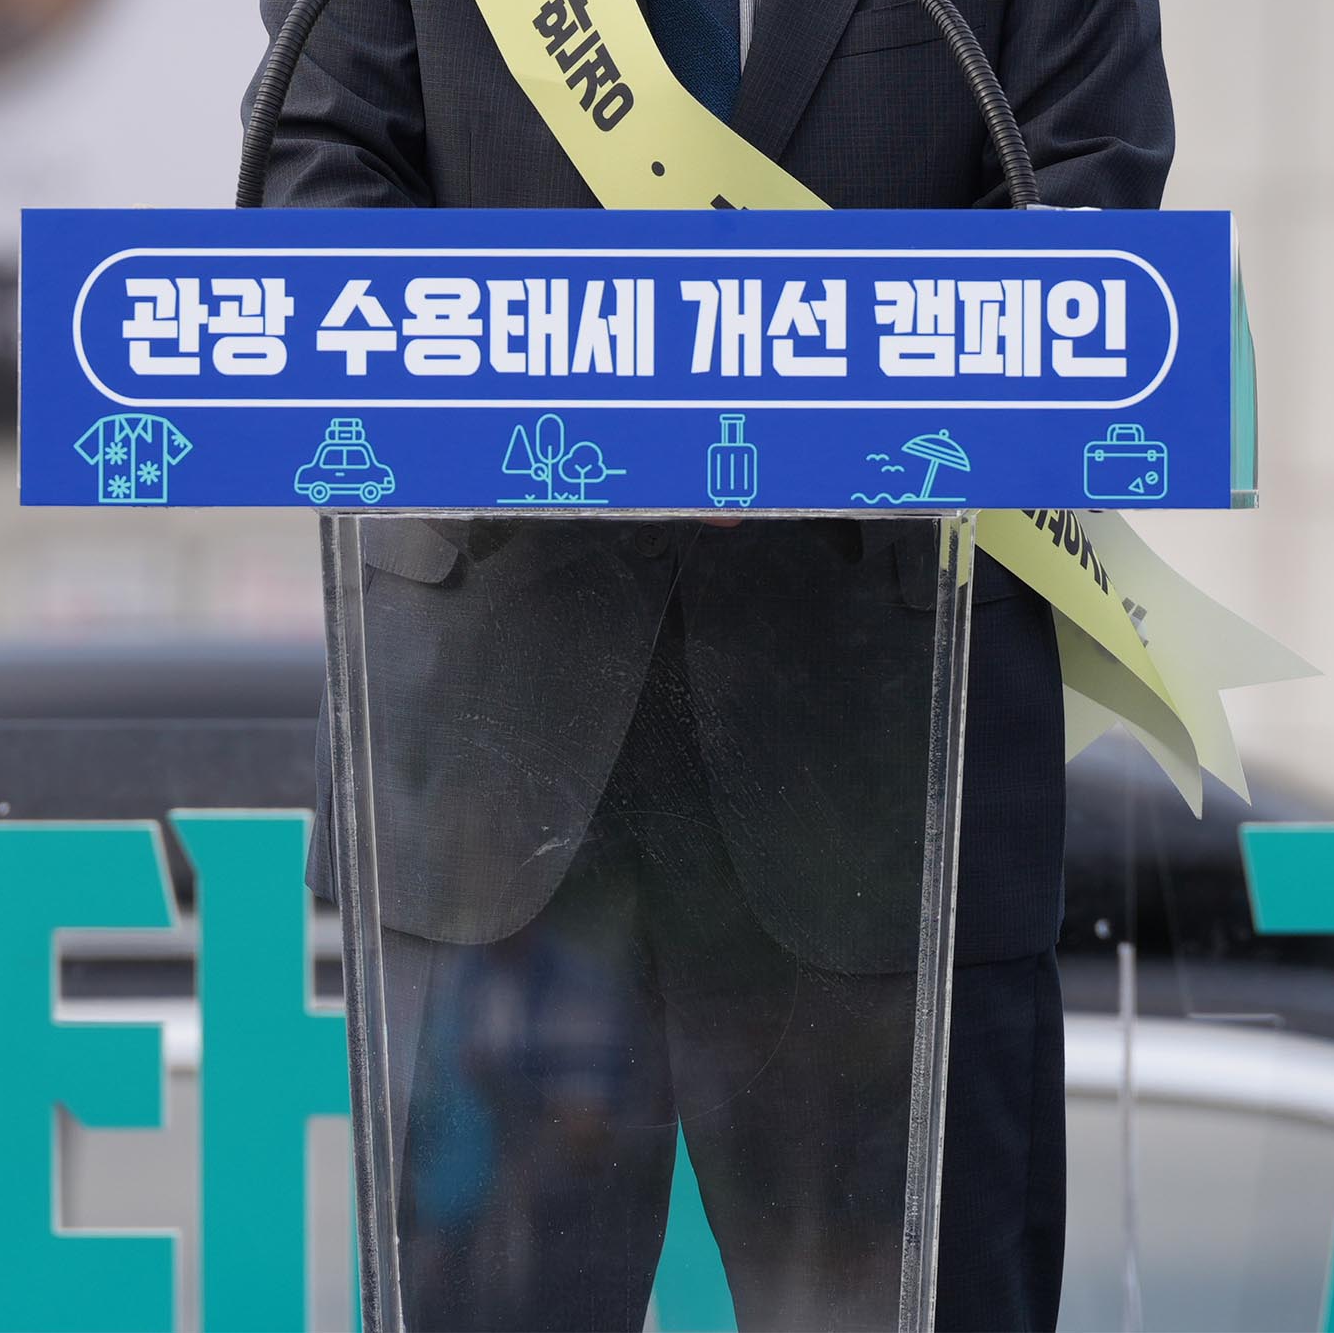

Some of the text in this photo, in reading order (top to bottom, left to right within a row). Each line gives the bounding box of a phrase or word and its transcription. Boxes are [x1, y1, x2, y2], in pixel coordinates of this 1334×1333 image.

[122, 278, 294, 375] 관광
[316, 278, 653, 375] 수용태세
[680, 278, 846, 375] 개선
[874, 278, 1127, 376] 캠페인
